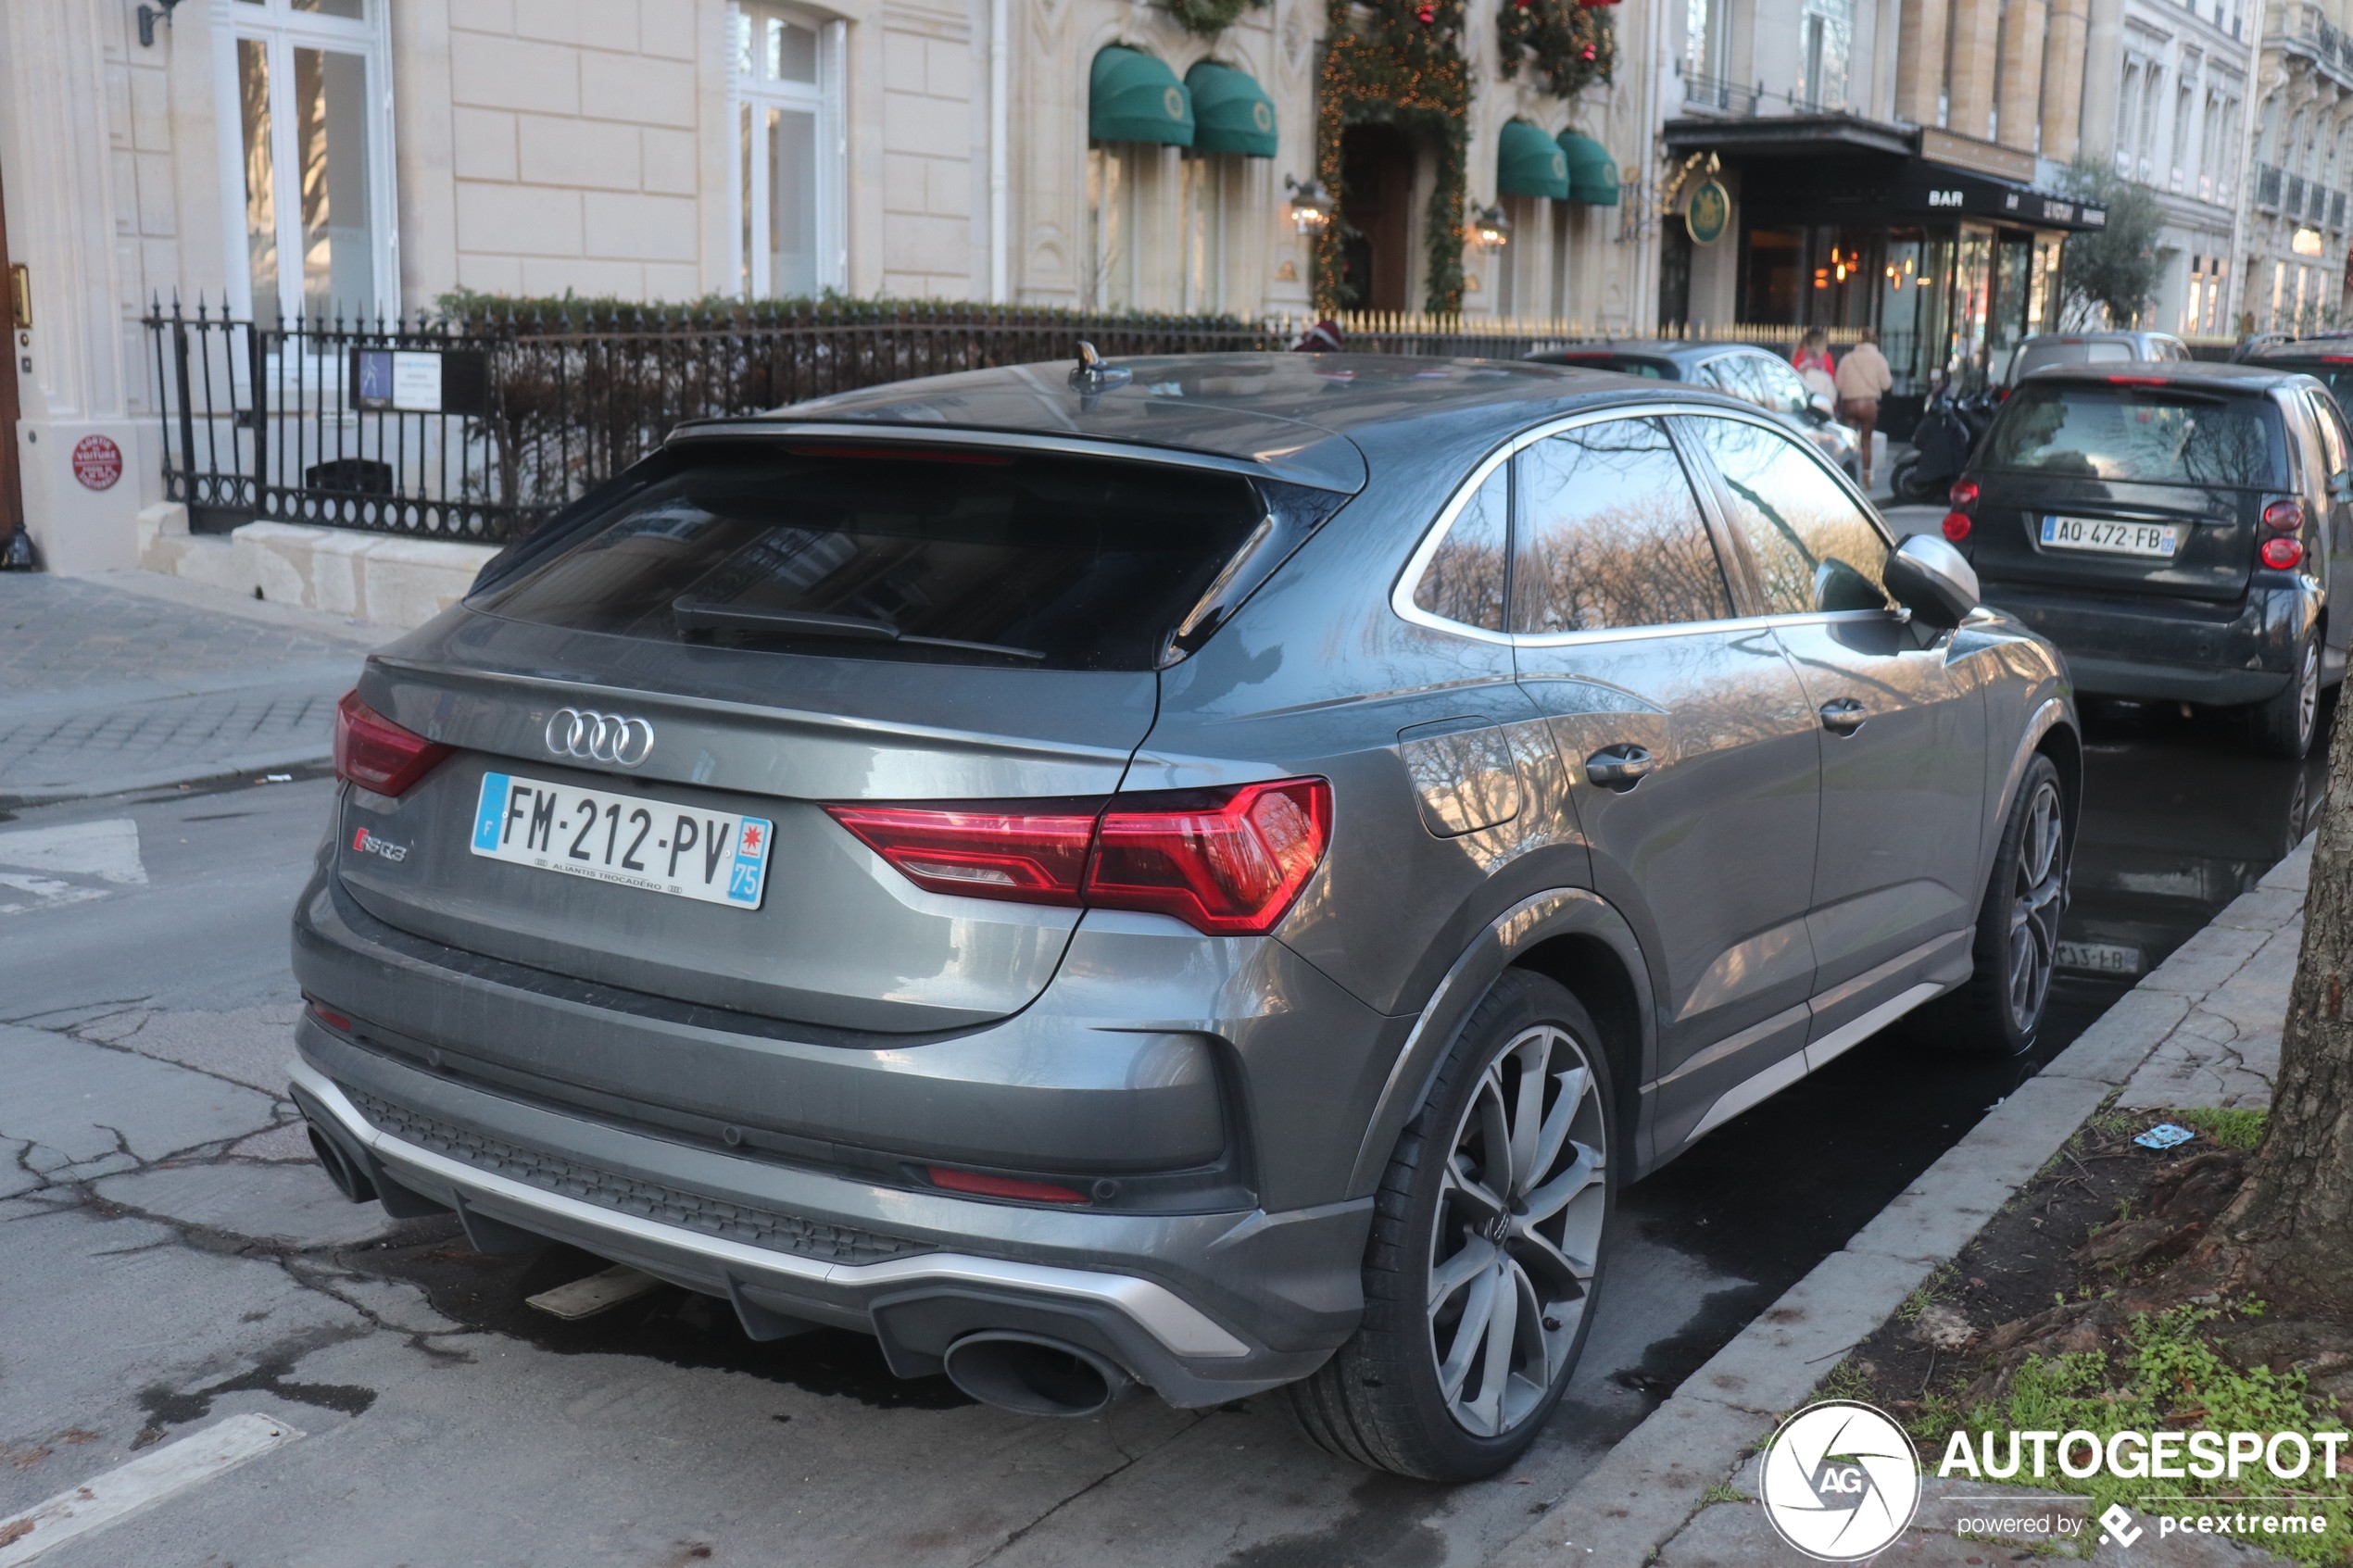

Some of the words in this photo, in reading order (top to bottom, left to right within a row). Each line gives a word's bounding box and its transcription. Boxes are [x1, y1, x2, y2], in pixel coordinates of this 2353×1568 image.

[1928, 189, 1964, 207] BAR
[77, 450, 117, 461] VOITURE
[483, 820, 494, 837] F
[503, 785, 731, 884] FM-212-PV
[552, 863, 597, 878] ALIANTIS
[732, 863, 758, 895] 75
